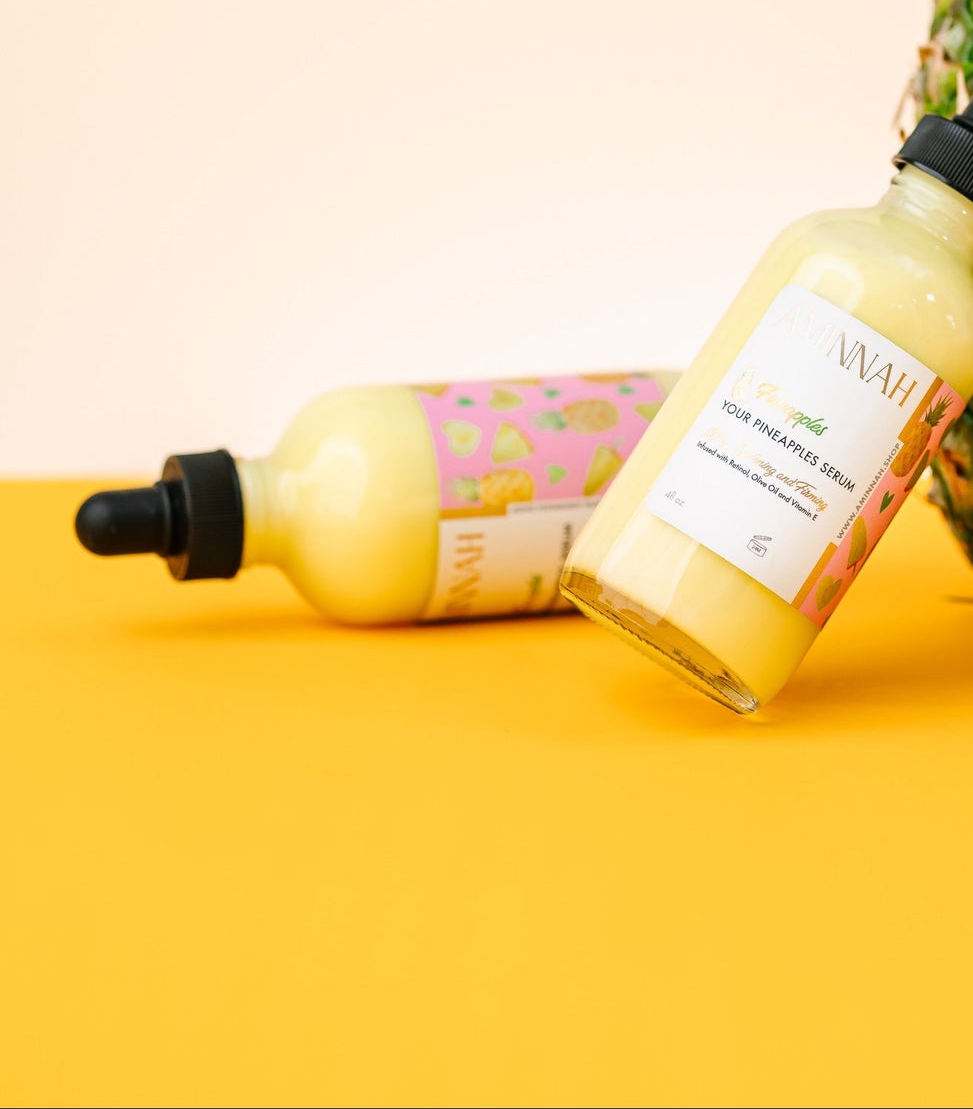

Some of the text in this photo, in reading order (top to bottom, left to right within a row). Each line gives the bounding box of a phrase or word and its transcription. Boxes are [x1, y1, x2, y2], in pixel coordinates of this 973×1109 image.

[697, 440, 819, 522] Infused with Retinol, Olive Oil and Vitamin E
[721, 399, 752, 424] YOUR
[753, 418, 820, 466] PINEAPPLES
[820, 462, 856, 493] SERUM
[776, 470, 829, 512] and Firming
[837, 443, 900, 539] WWW.AMINNAH.SHOP
